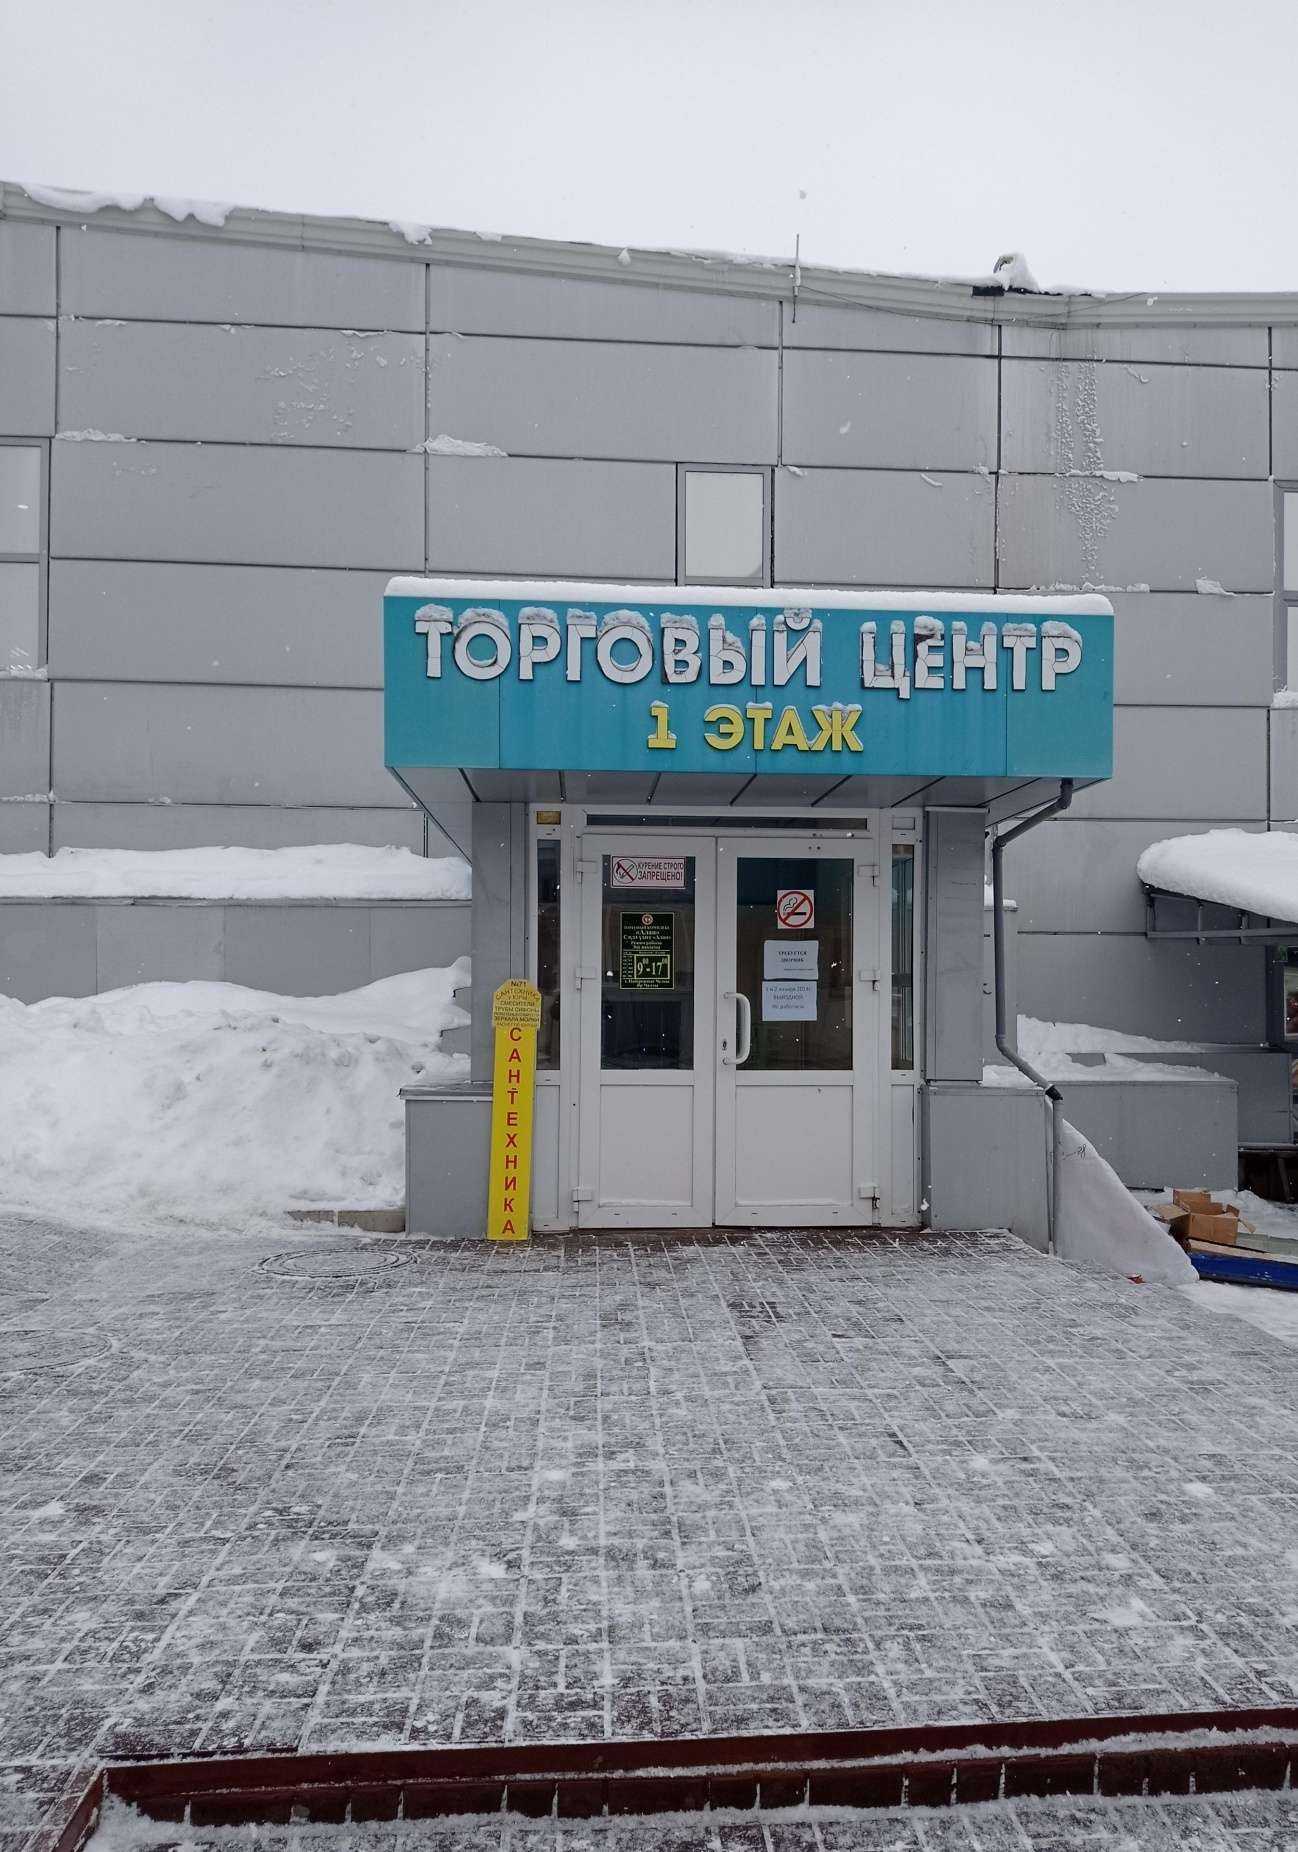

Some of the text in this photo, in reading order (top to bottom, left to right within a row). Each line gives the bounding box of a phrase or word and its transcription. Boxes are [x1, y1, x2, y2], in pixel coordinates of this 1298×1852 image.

[415, 611, 1083, 700] ТОРГОВЫЙ ЦЕНТР
[647, 703, 864, 752] 1 ЭТАЖ
[637, 871, 683, 882] ЗАПРЕЩЕНО!
[638, 862, 684, 870] КУРЕНИЕ СТРОГО
[501, 1027, 522, 1235] САНТЕХНИКА
